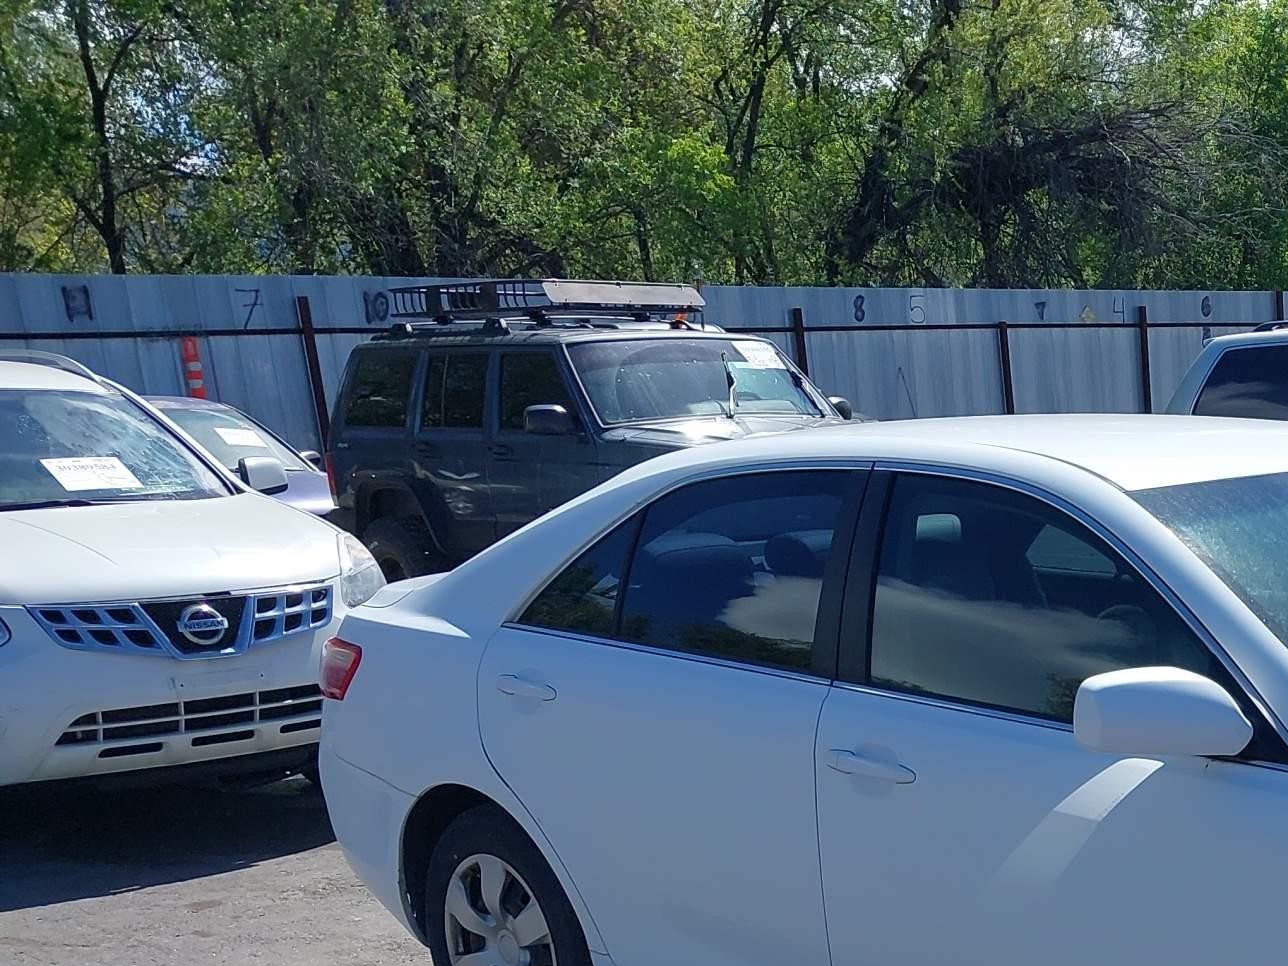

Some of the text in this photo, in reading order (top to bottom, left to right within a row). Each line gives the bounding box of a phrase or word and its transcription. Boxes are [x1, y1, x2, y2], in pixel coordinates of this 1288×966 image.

[235, 288, 263, 329] 7
[853, 294, 865, 322] 8
[909, 295, 926, 324] 5
[1112, 296, 1125, 323] 4
[1200, 295, 1212, 317] 6
[184, 619, 224, 630] NISSAN
